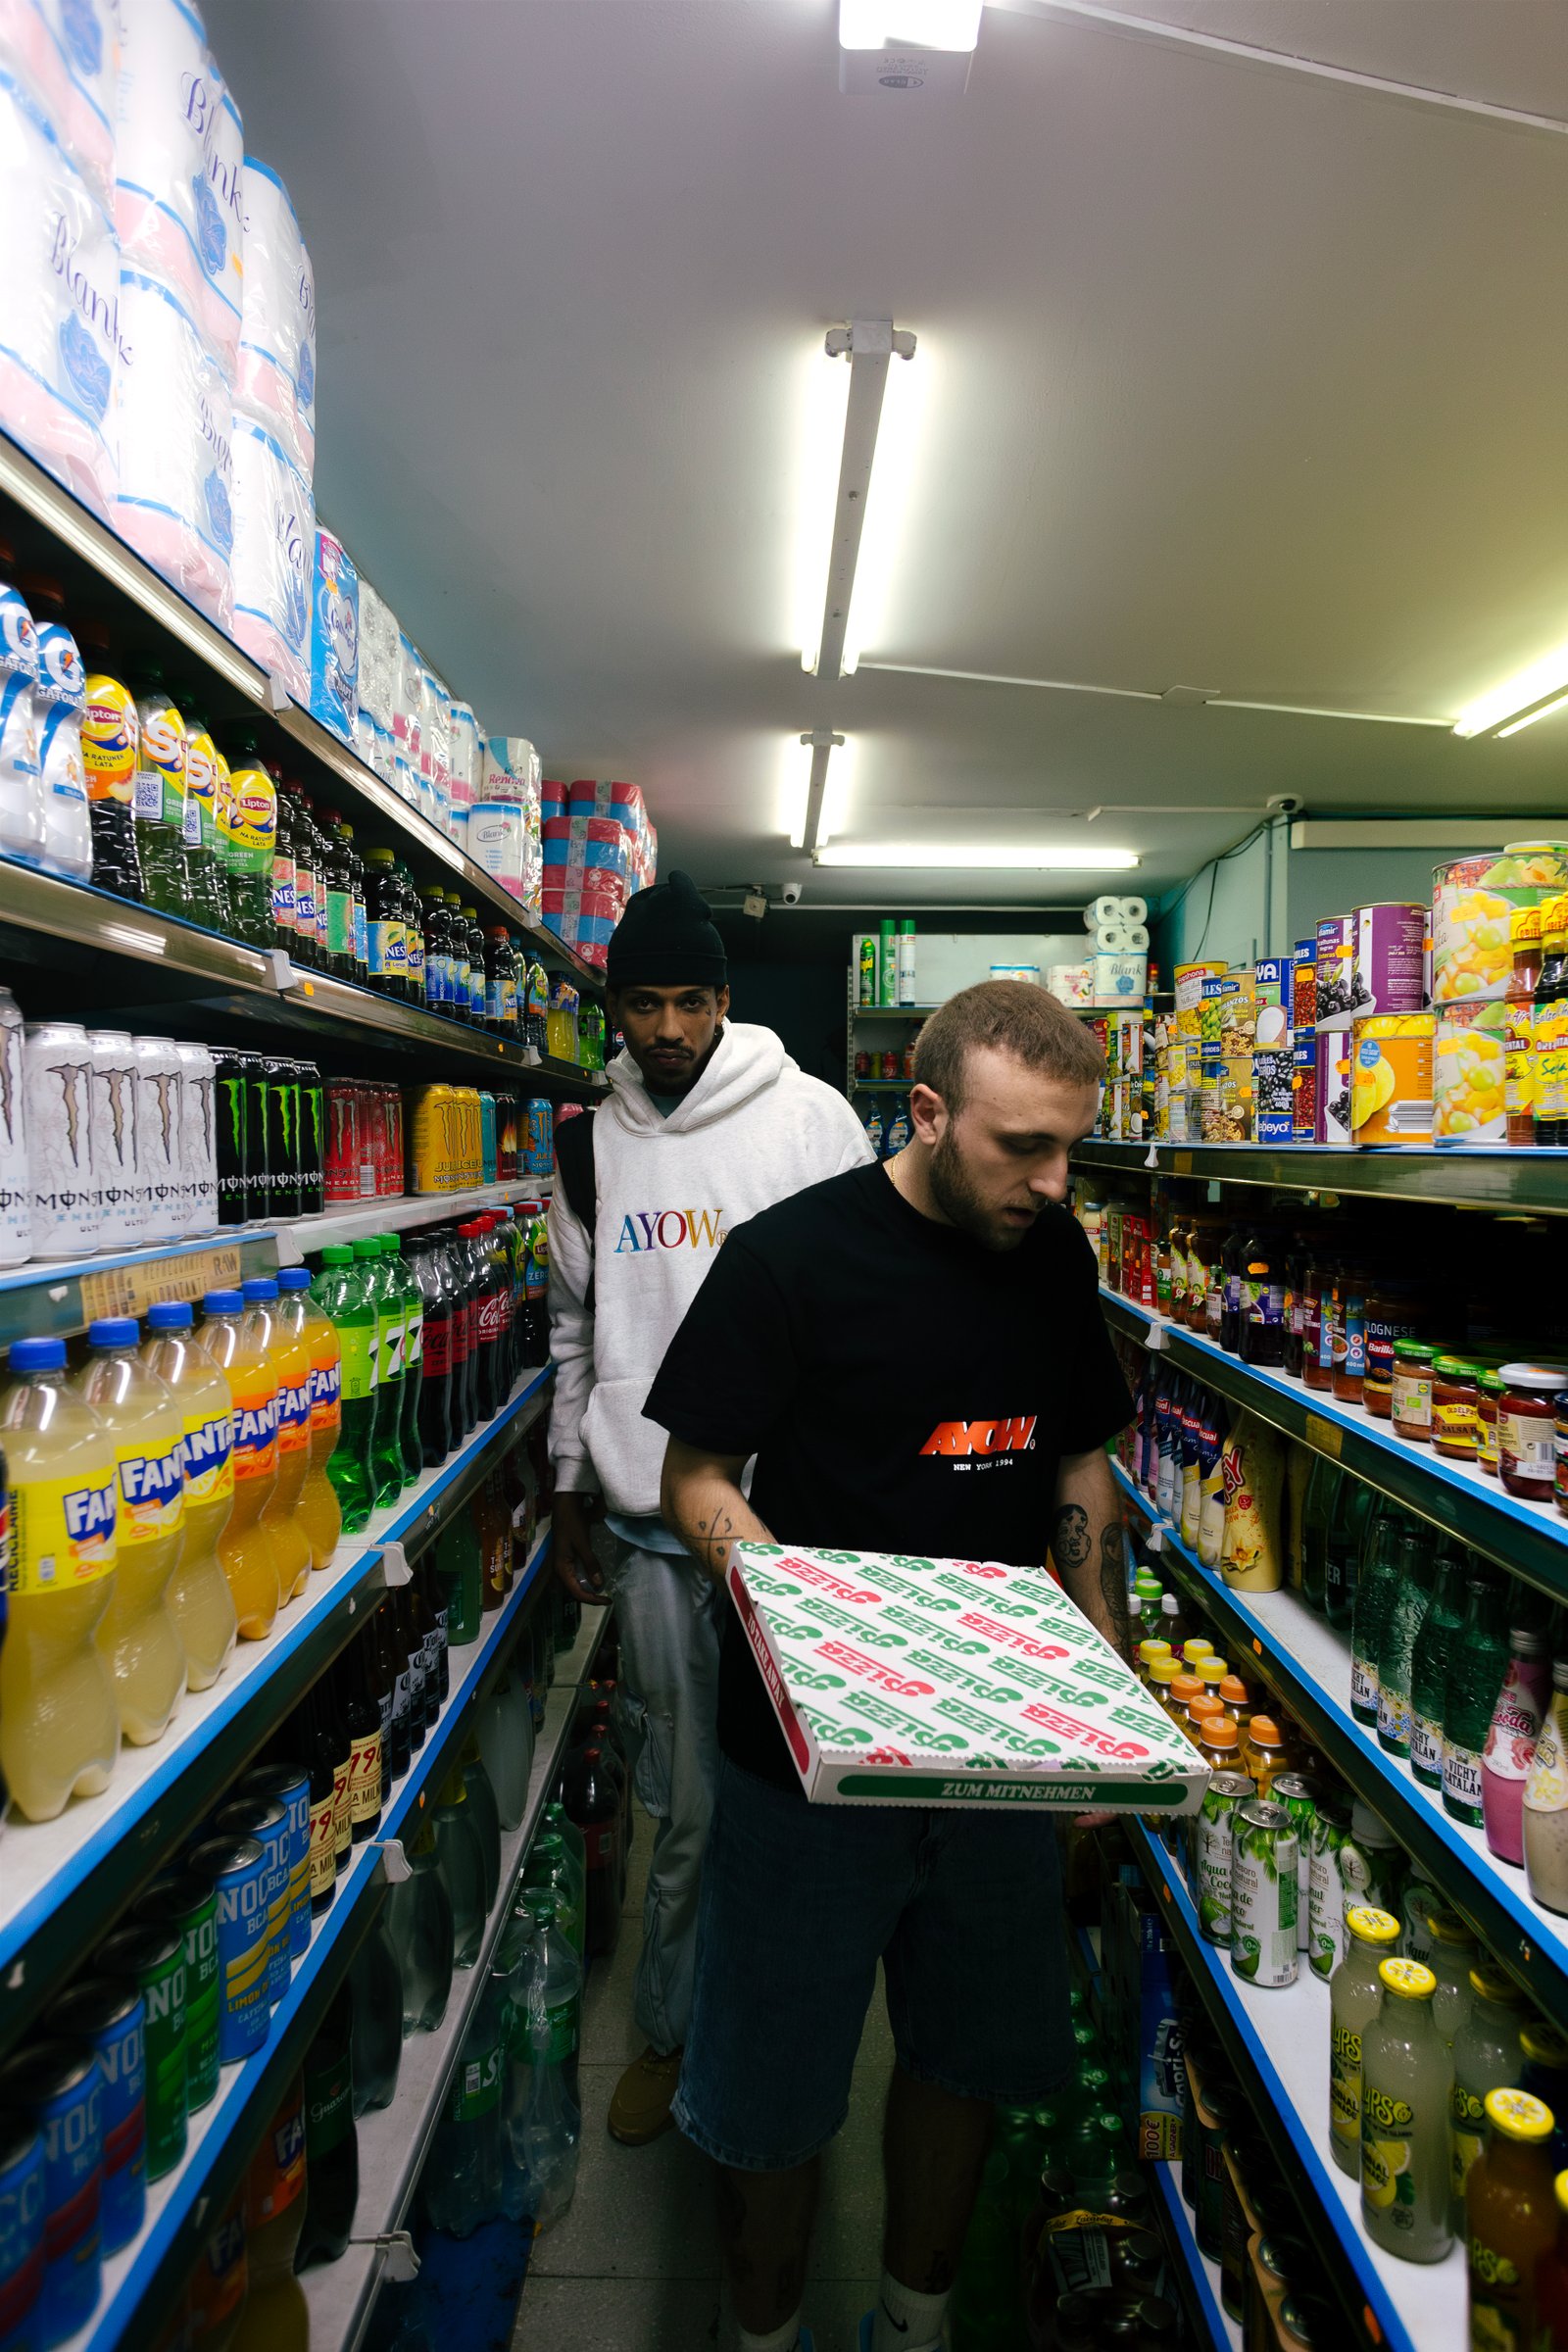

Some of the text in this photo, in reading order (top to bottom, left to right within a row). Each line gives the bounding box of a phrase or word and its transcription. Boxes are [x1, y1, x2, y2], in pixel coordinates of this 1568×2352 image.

[86, 707, 122, 721] ipton
[241, 799, 270, 810] Lipton
[1110, 961, 1145, 976] Blank
[613, 1208, 723, 1253] AYOW
[1368, 1342, 1395, 1355] Barilla
[919, 1415, 1038, 1456] AYOW
[1441, 1424, 1468, 1435] SALSA
[976, 1461, 993, 1470] YORK
[996, 1458, 1013, 1467] 1994
[781, 1556, 882, 1604] Pizza
[860, 1565, 961, 1612] Pizza
[935, 1572, 1038, 1618] Pizza
[801, 1597, 908, 1648] Pizza
[884, 1606, 991, 1655] Pizza
[961, 1612, 1070, 1661] Pizza
[754, 1635, 769, 1670] TAKE
[765, 1668, 785, 1708] AWAY
[819, 1641, 936, 1697] Pizza
[908, 1650, 1024, 1704] Pizza
[992, 1656, 1109, 1708] Pizza
[844, 1691, 969, 1752] Pizza
[937, 1697, 1061, 1757] Pizza
[1025, 1704, 1150, 1760] Pizza
[942, 1783, 1097, 1800] ZUM MITNEHMEN
[1447, 1758, 1477, 1780] VICHY
[1200, 1858, 1227, 1876] Agua
[1145, 2118, 1160, 2160] 100€
